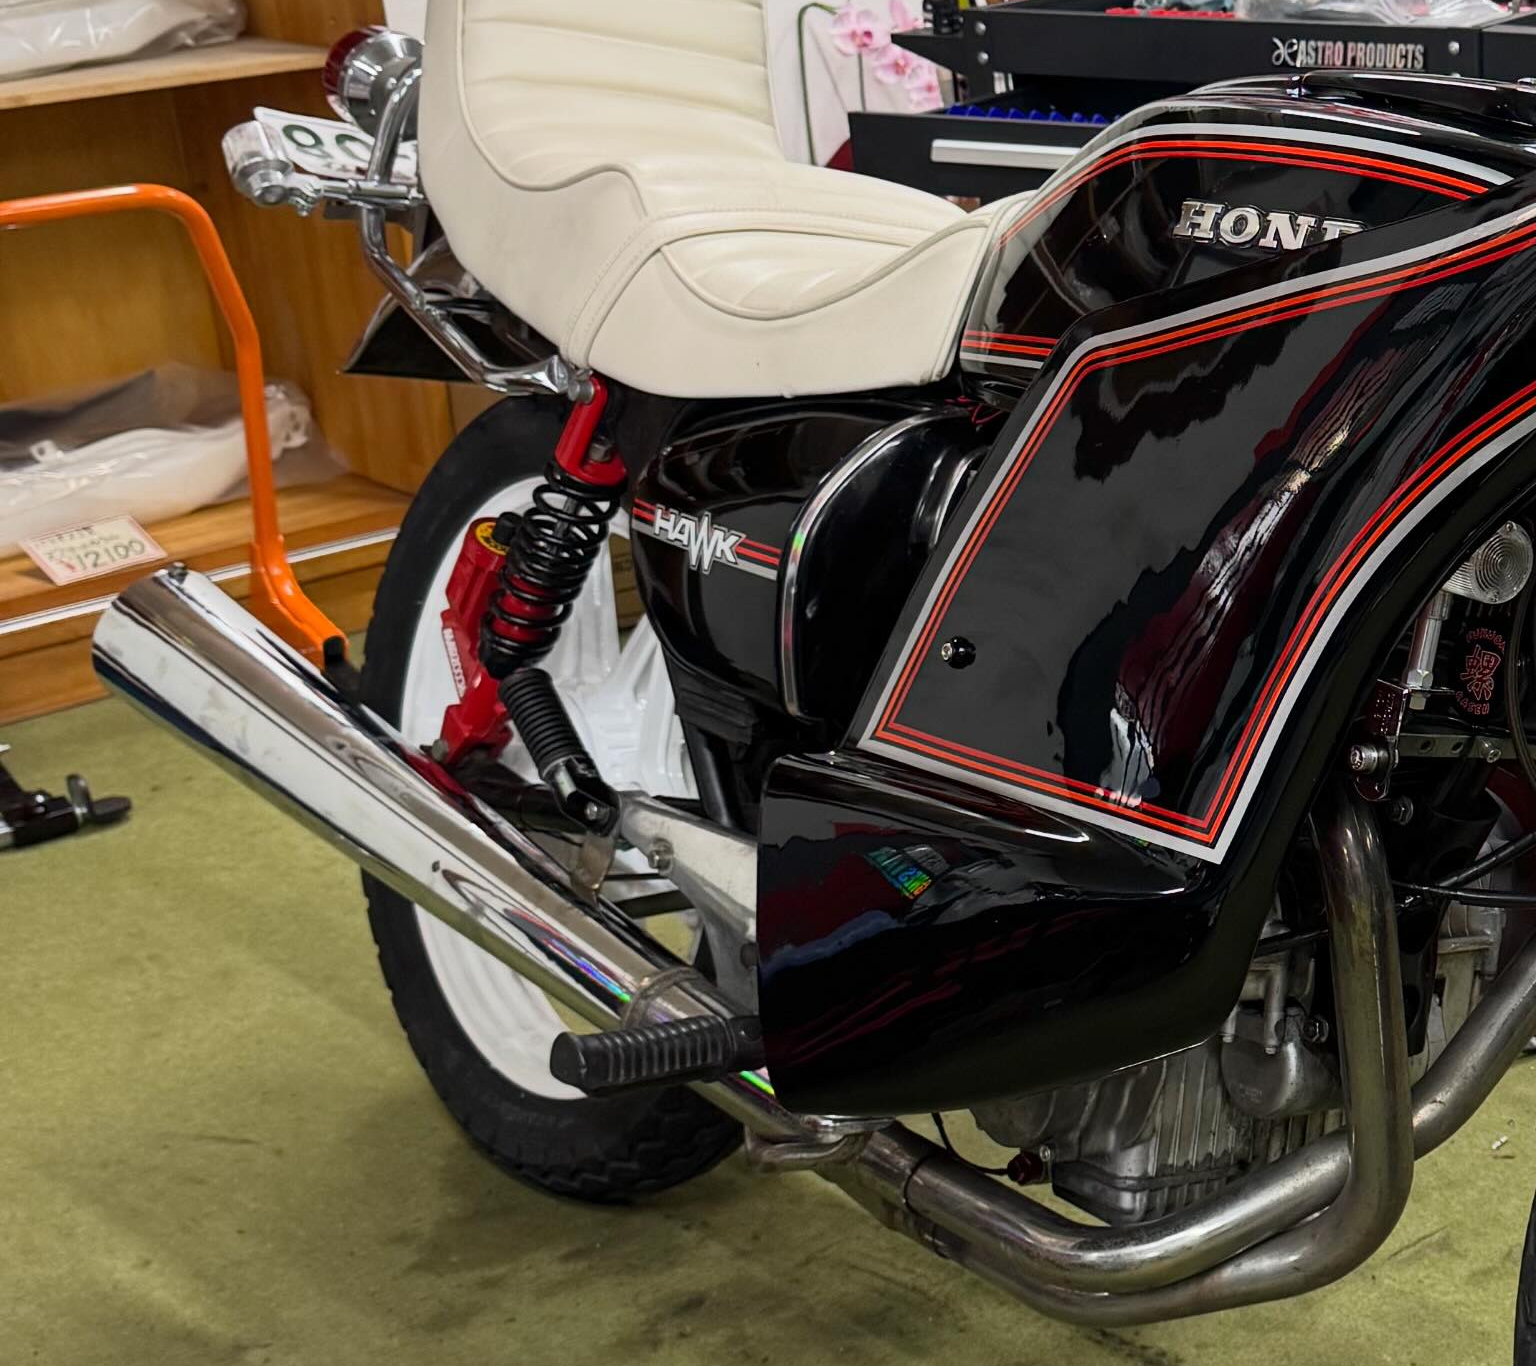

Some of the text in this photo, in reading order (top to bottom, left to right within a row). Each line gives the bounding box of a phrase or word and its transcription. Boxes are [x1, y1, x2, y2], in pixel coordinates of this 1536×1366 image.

[1297, 38, 1425, 70] ASTRO PRODUCTS
[653, 504, 744, 573] HAWK
